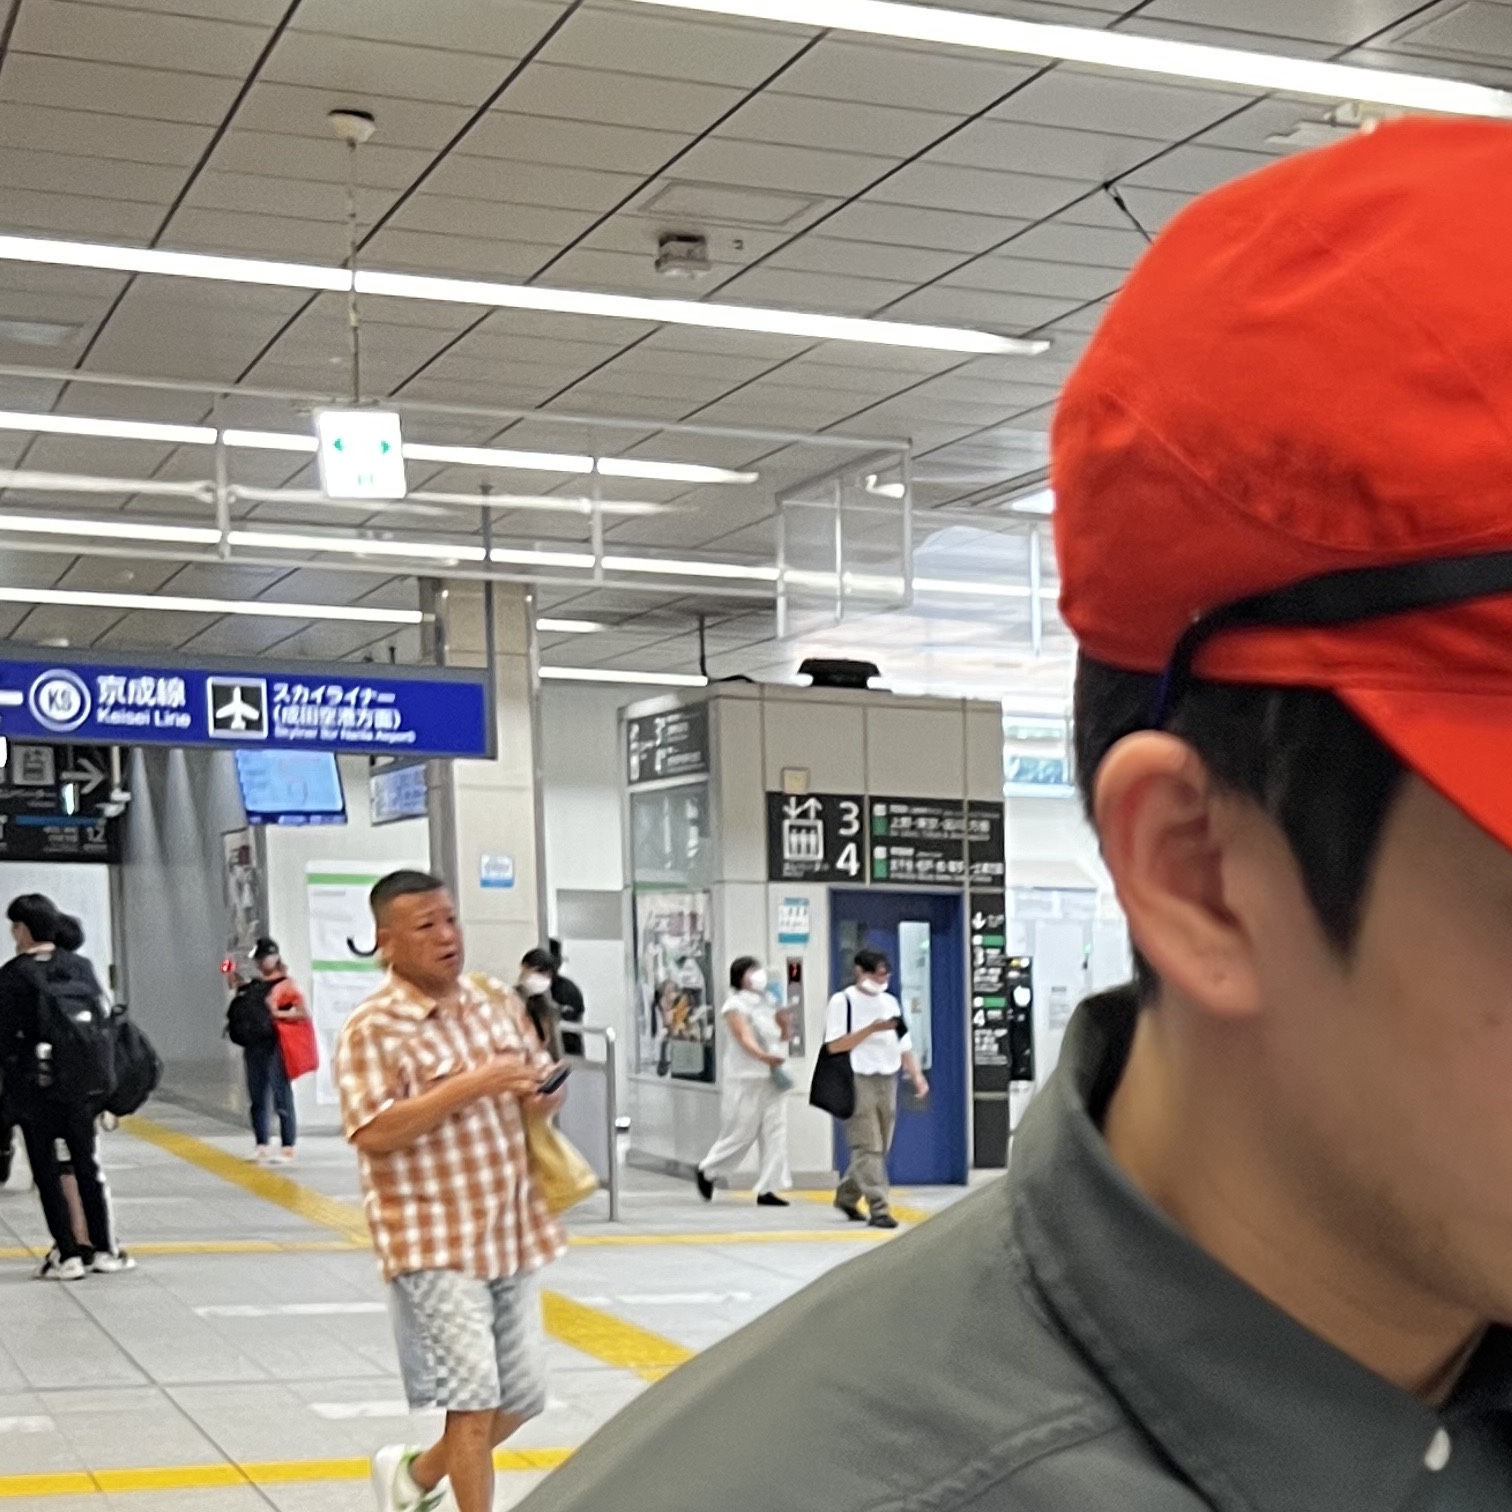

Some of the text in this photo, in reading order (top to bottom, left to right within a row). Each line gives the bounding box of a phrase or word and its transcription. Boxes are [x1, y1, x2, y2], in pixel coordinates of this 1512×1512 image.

[273, 682, 396, 704] スカイライナー
[97, 708, 192, 728] Keisei Line
[838, 801, 860, 836] 3
[835, 841, 861, 877] 4
